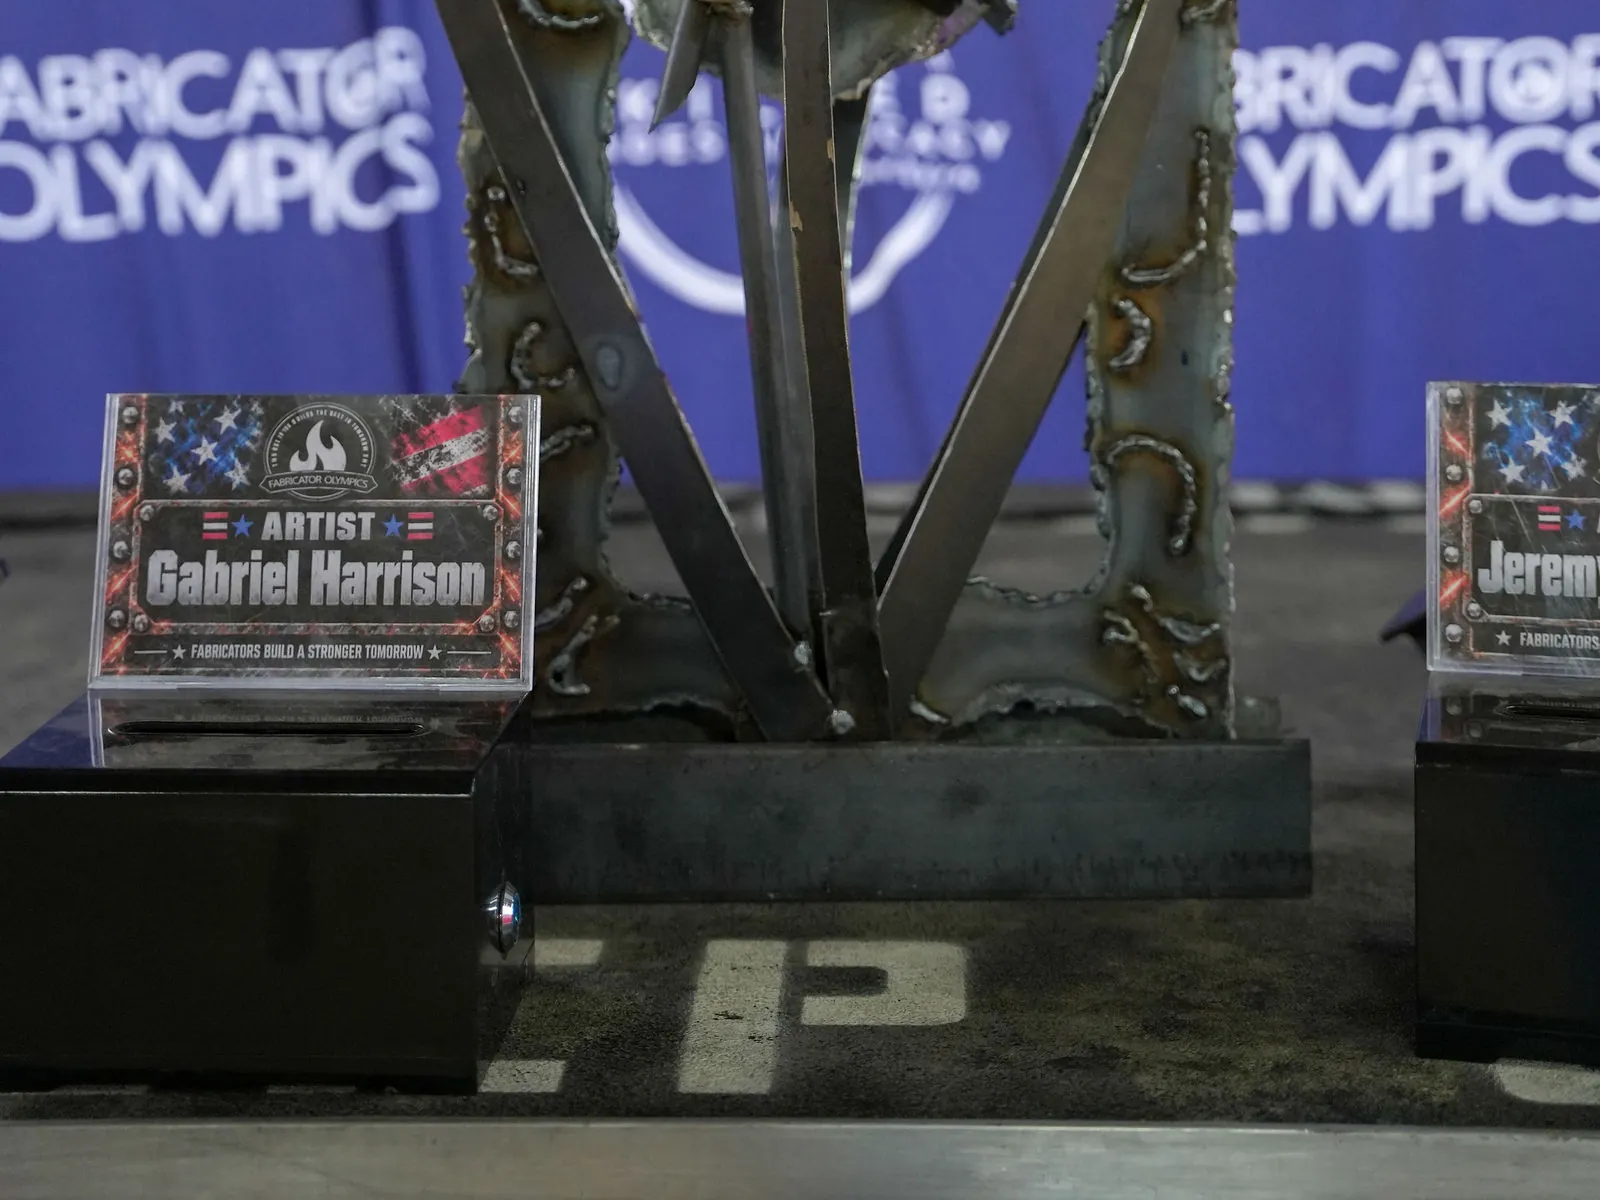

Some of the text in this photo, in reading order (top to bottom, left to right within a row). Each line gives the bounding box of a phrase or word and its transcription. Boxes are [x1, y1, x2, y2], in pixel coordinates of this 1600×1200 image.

[268, 475, 369, 489] FABRICATOR OLYMPICS
[261, 511, 376, 541] ARTIST
[146, 549, 486, 606] Gabriel Harrison
[1478, 540, 1600, 609] Jerem
[190, 643, 424, 659] FABRICATORS BUILD A STRONGER TOMORROW
[1520, 632, 1600, 650] FABRICATORS
